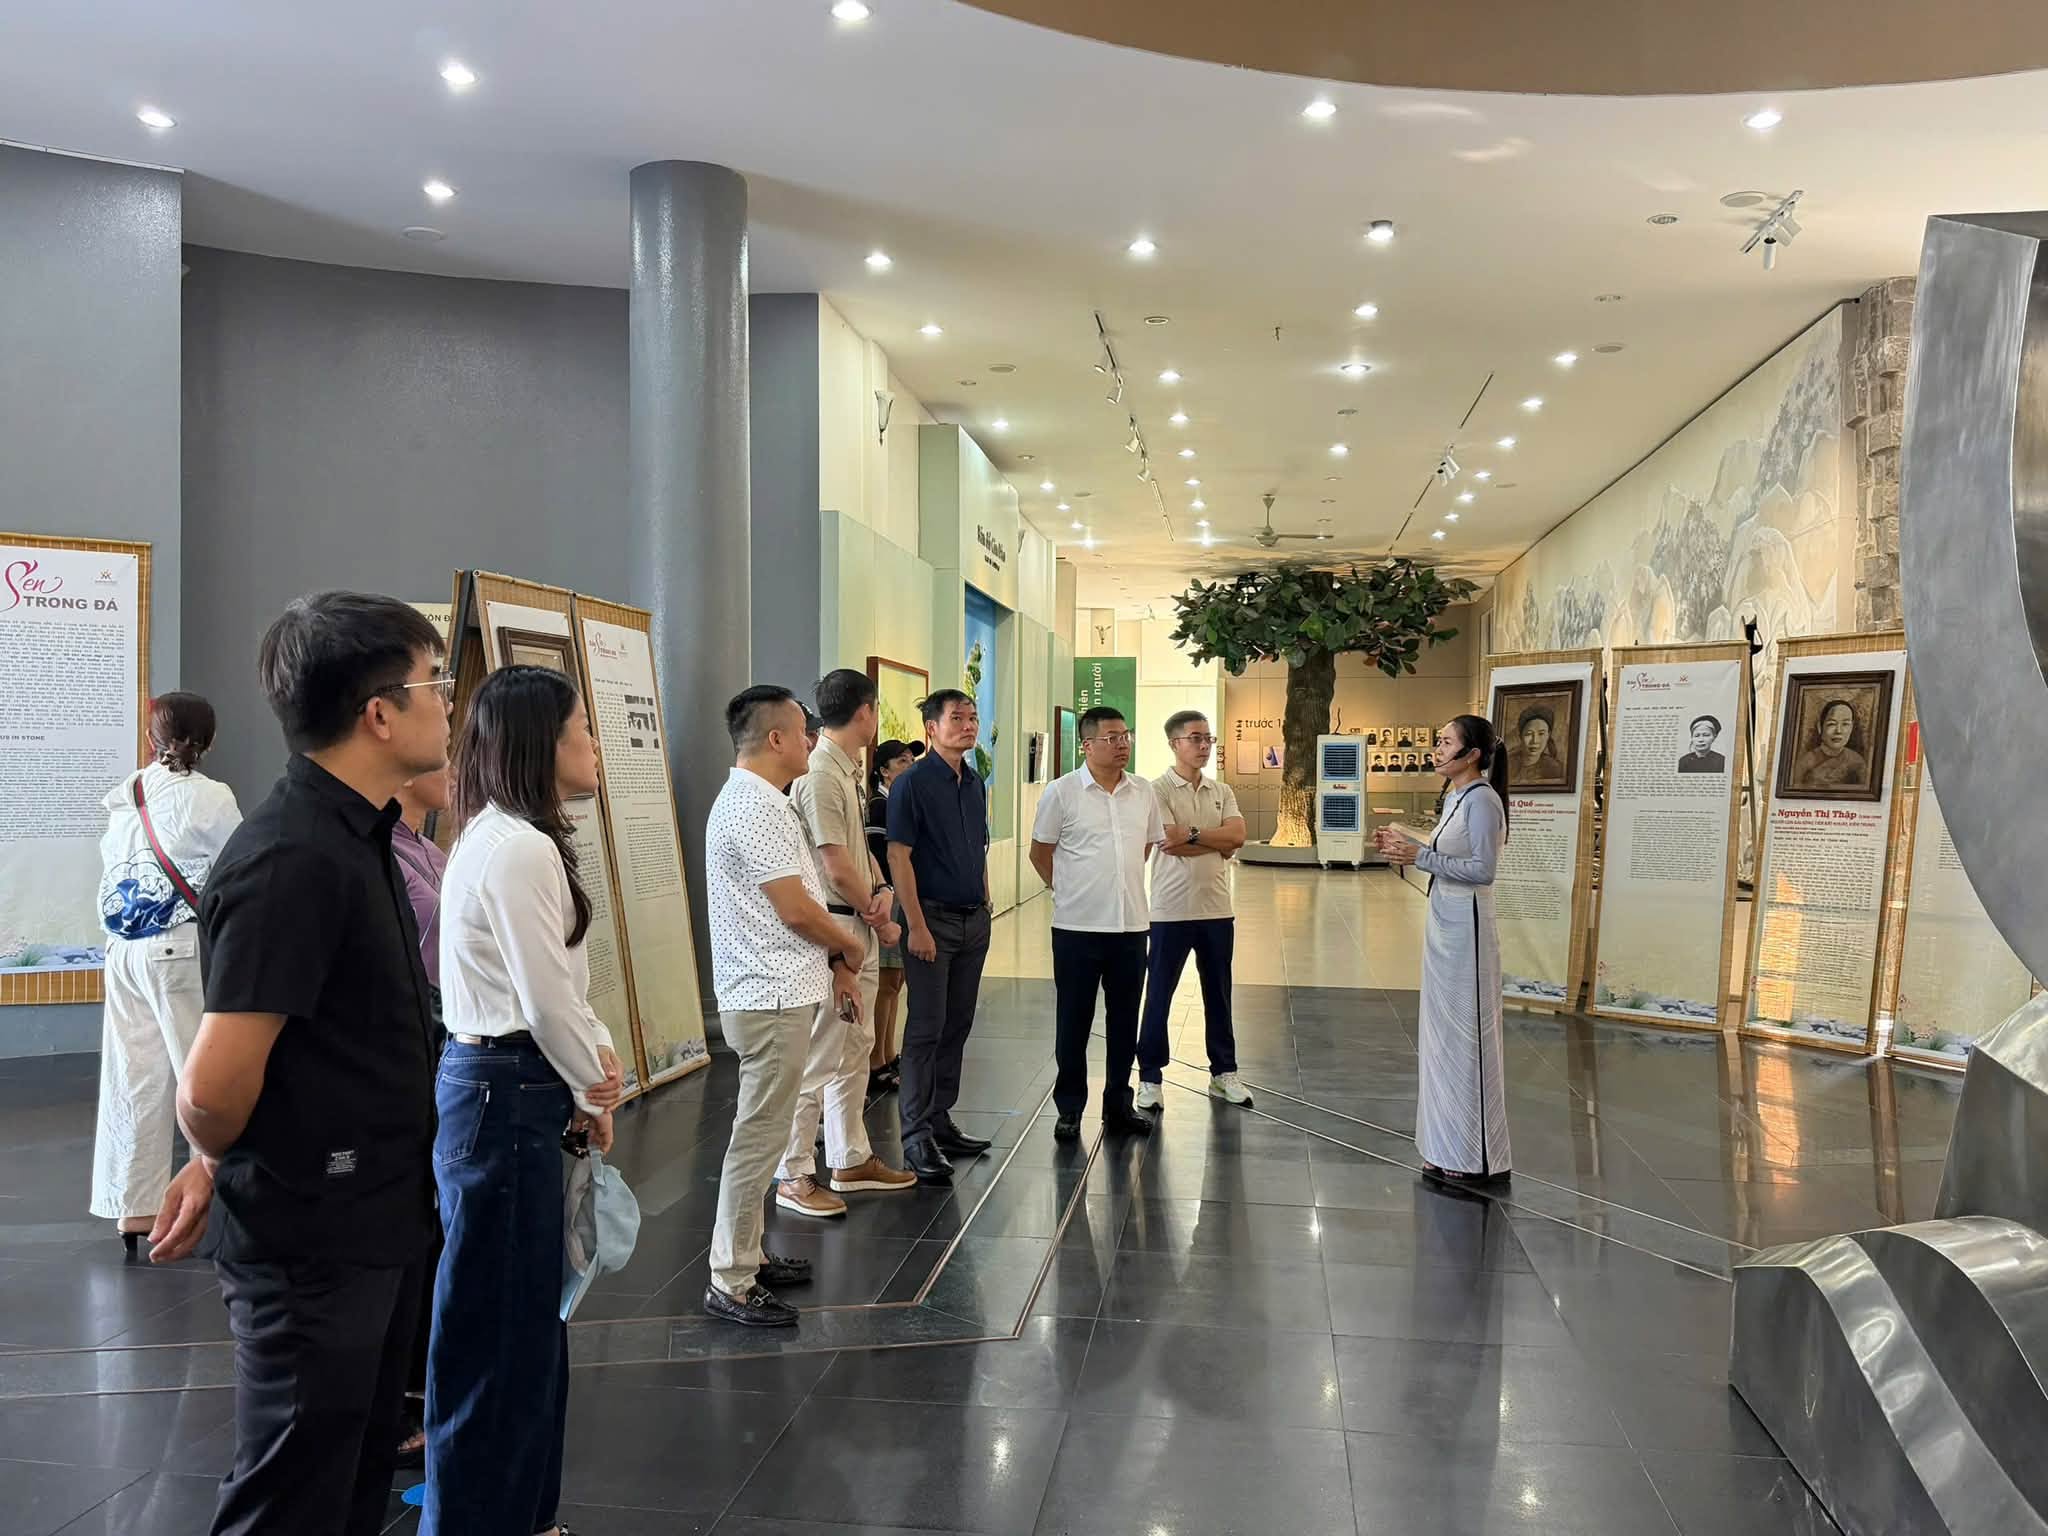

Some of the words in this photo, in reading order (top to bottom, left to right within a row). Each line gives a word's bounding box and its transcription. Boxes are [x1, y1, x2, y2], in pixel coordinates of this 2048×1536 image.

[0, 559, 63, 613] Sen
[23, 595, 88, 610] TRONG
[94, 597, 118, 611] ĐÁ
[1091, 662, 1104, 696] người
[1078, 689, 1089, 714] hiên
[1245, 717, 1273, 729] trước
[1778, 808, 1812, 819] Nguyễn
[1814, 809, 1830, 819] Thị
[1832, 810, 1857, 820] Thập
